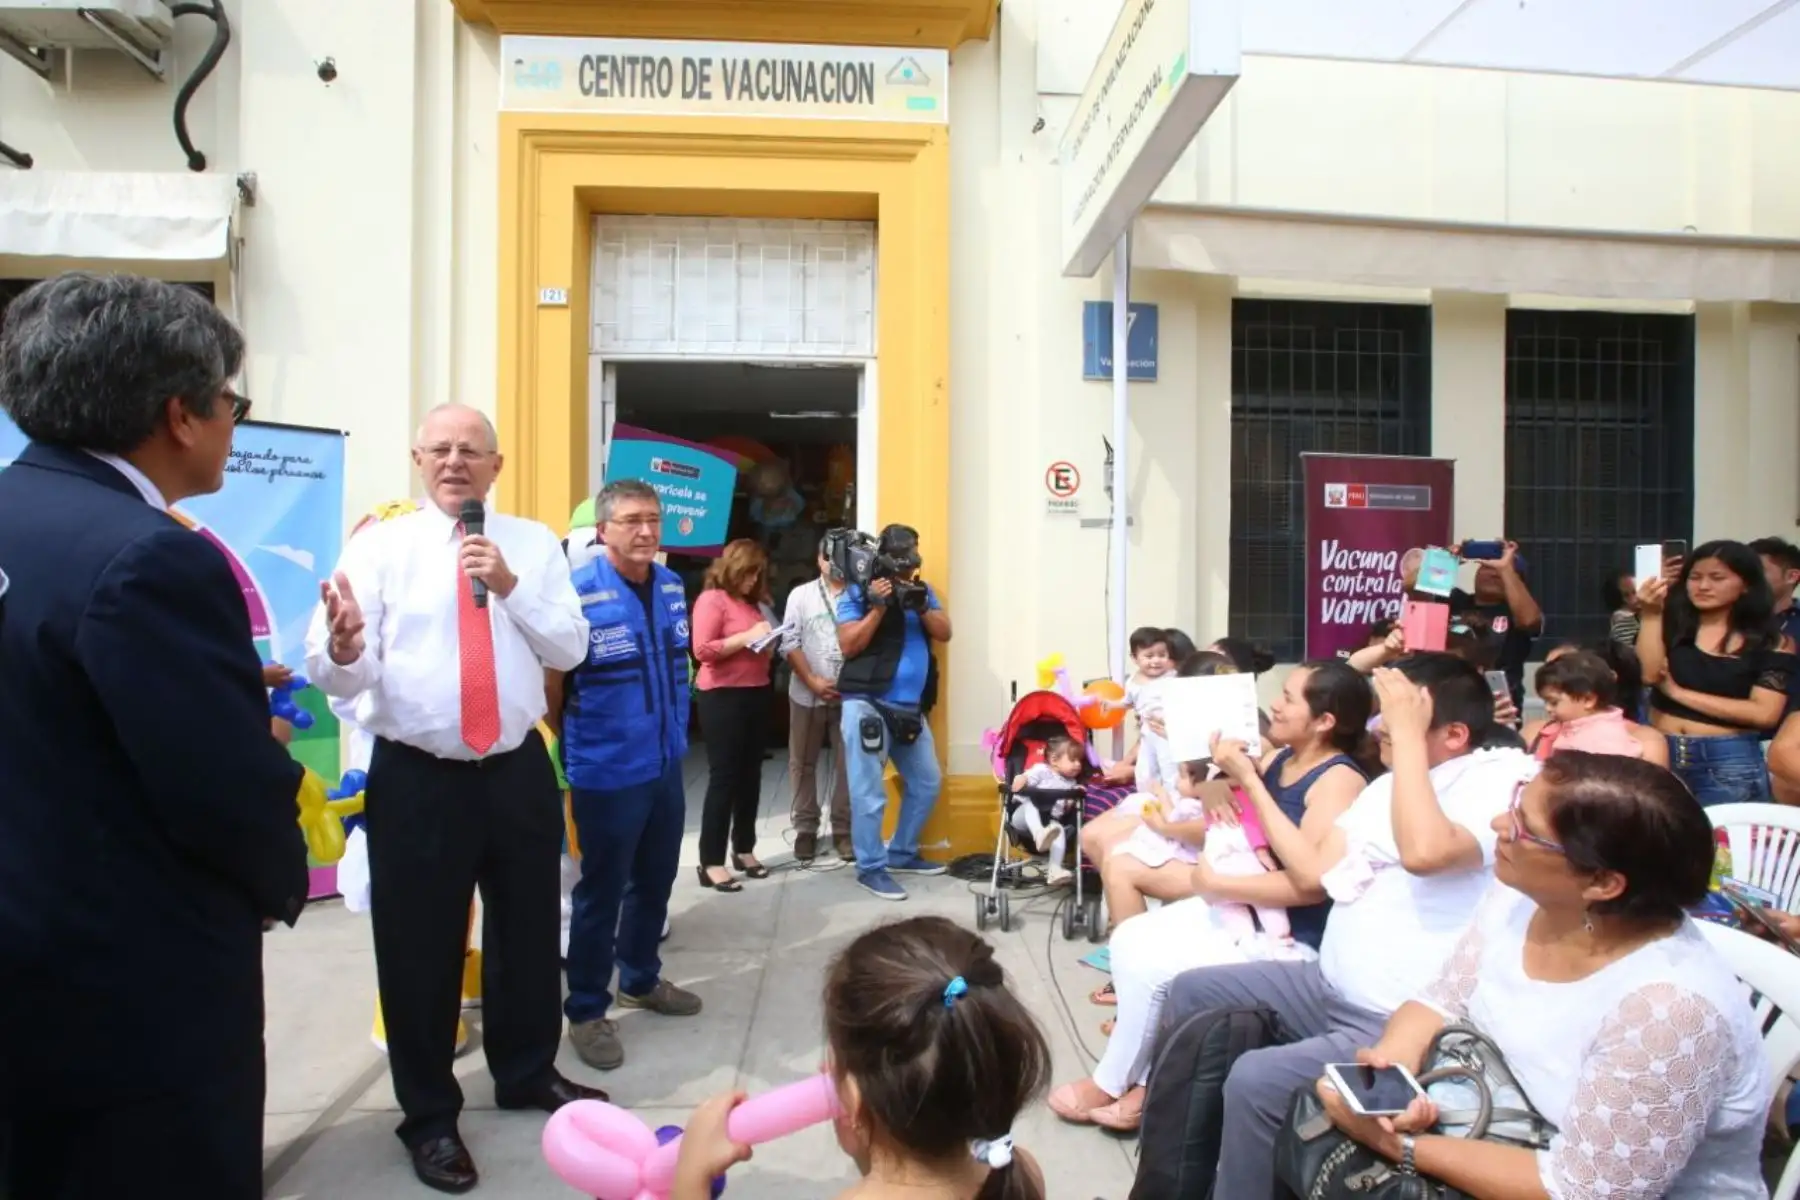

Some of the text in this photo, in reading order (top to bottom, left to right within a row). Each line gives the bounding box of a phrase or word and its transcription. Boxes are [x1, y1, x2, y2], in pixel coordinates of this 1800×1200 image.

[578, 53, 674, 99] CENTRO
[681, 57, 712, 100] DE
[721, 57, 875, 105] VACUNACION
[228, 444, 279, 466] bajando
[1055, 468, 1071, 490] E
[1321, 539, 1398, 573] Vacuna
[1322, 572, 1402, 596] contra la
[1321, 592, 1409, 625] varicel
